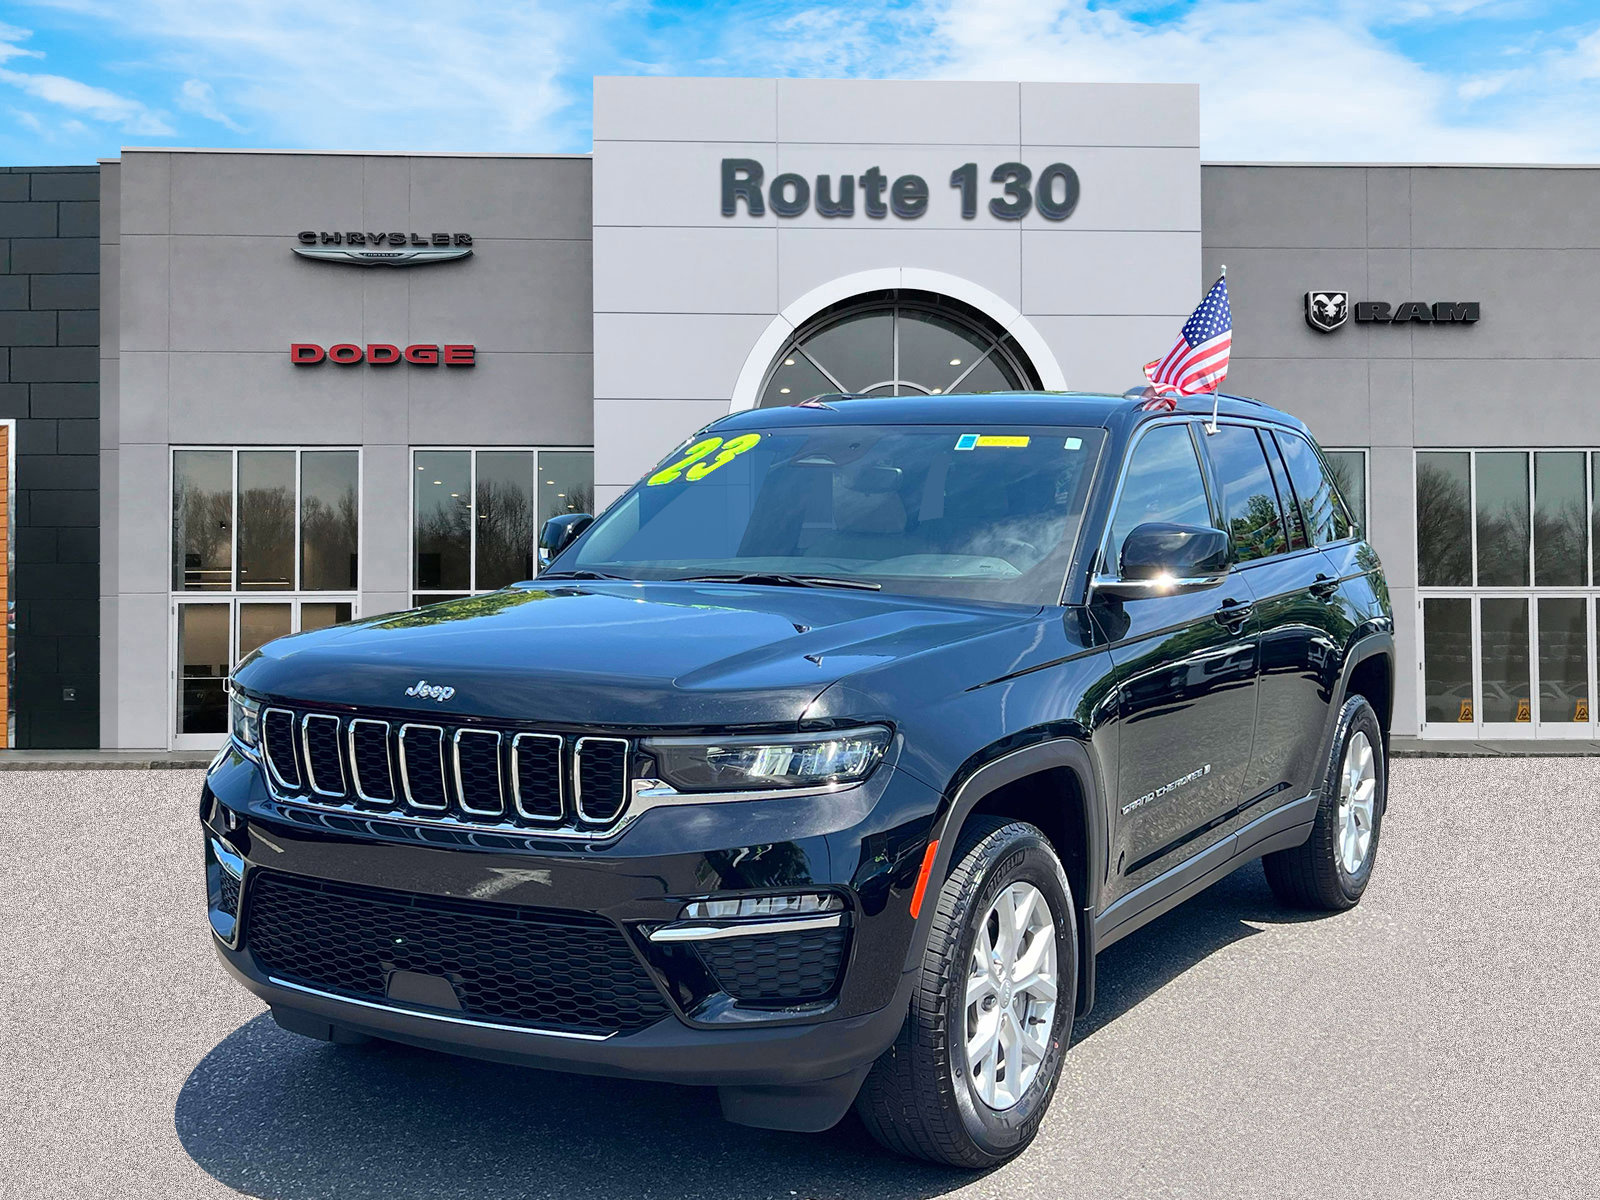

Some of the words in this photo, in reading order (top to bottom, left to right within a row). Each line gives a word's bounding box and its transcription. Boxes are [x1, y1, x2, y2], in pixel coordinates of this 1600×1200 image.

[721, 158, 929, 218] Route
[950, 162, 1080, 221] 130
[298, 231, 473, 245] CHRYSLER
[1354, 302, 1480, 324] RAM
[291, 343, 475, 365] DODGE
[646, 433, 761, 486] 23
[404, 680, 455, 701] Jeep
[1121, 792, 1155, 815] GRAND
[1155, 768, 1203, 797] CHEROKEE
